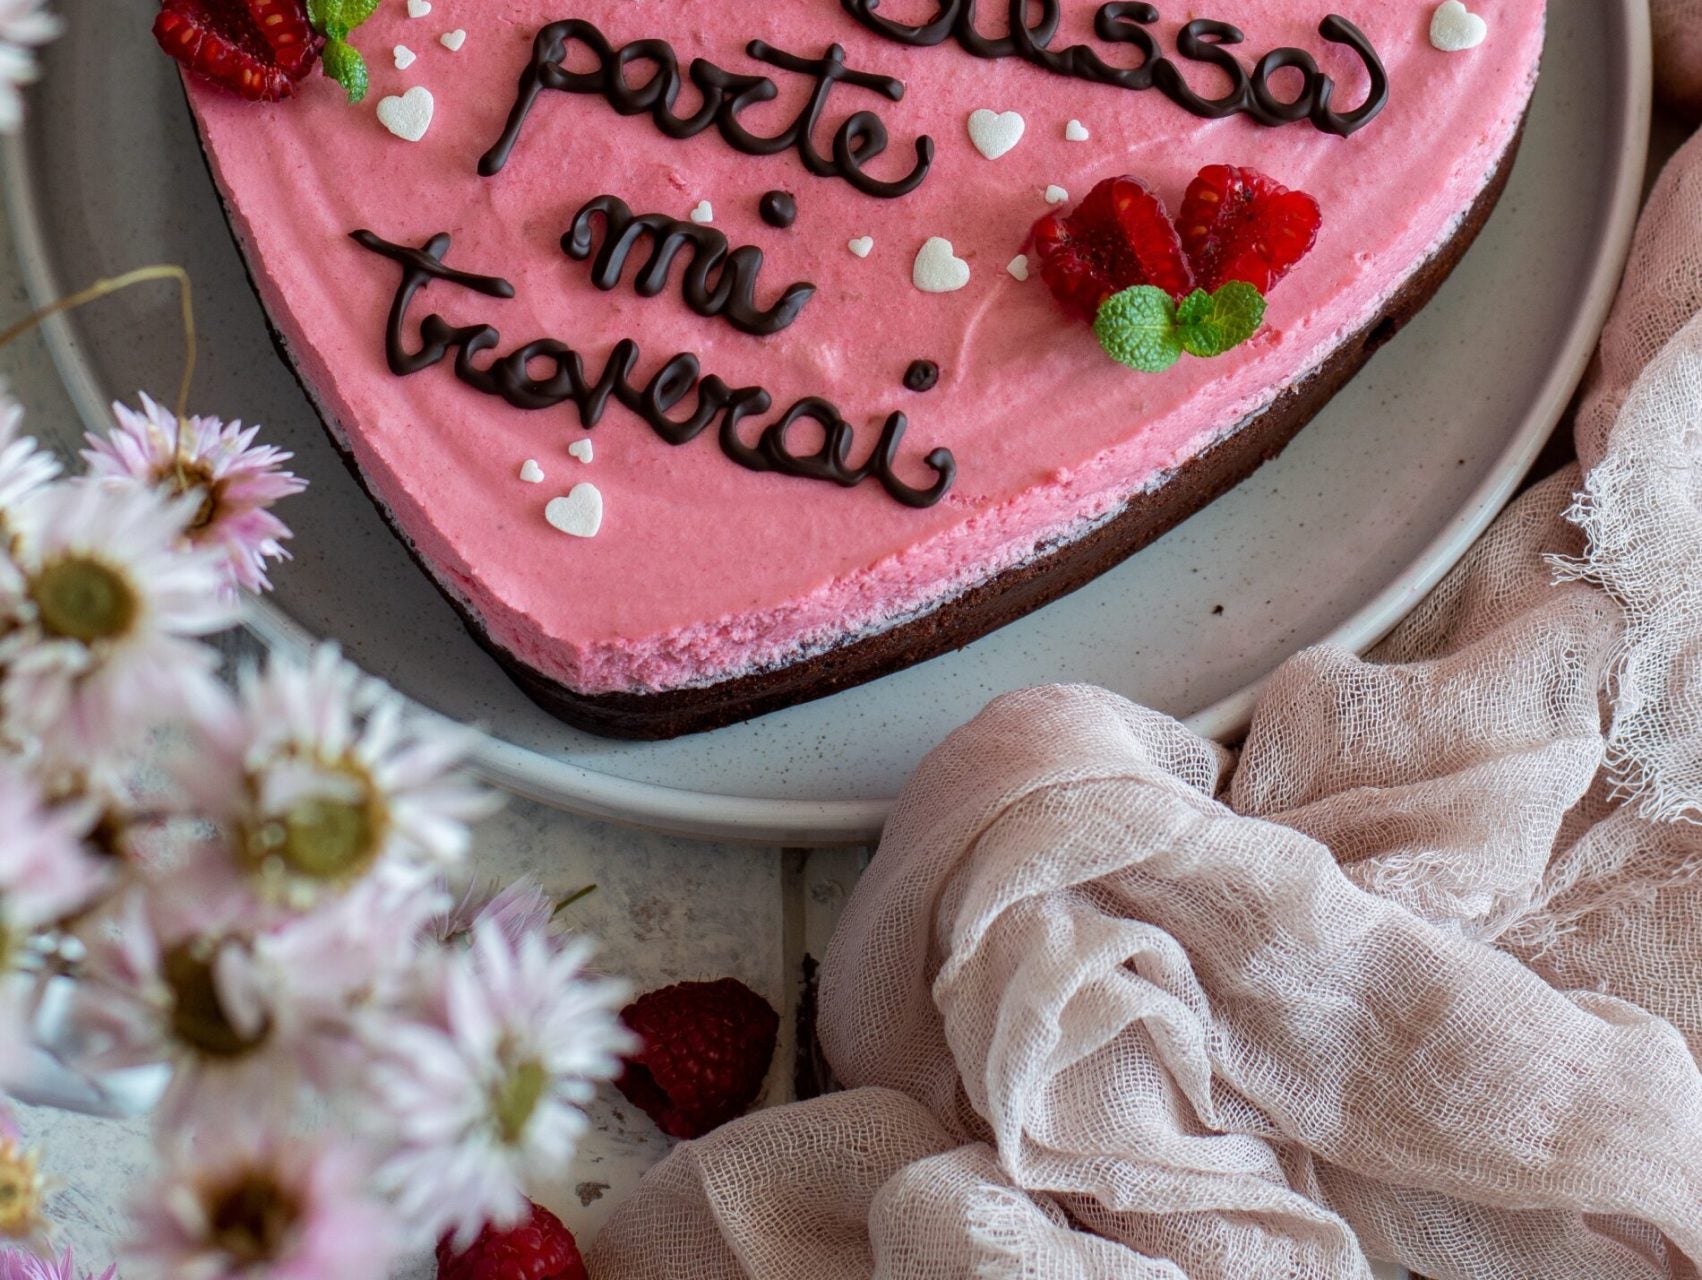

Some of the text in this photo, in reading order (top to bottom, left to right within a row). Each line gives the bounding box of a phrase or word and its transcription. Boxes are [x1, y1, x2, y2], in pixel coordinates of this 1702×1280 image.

[476, 18, 935, 199] parte
[560, 190, 817, 336] mi
[347, 228, 957, 510] troverai
